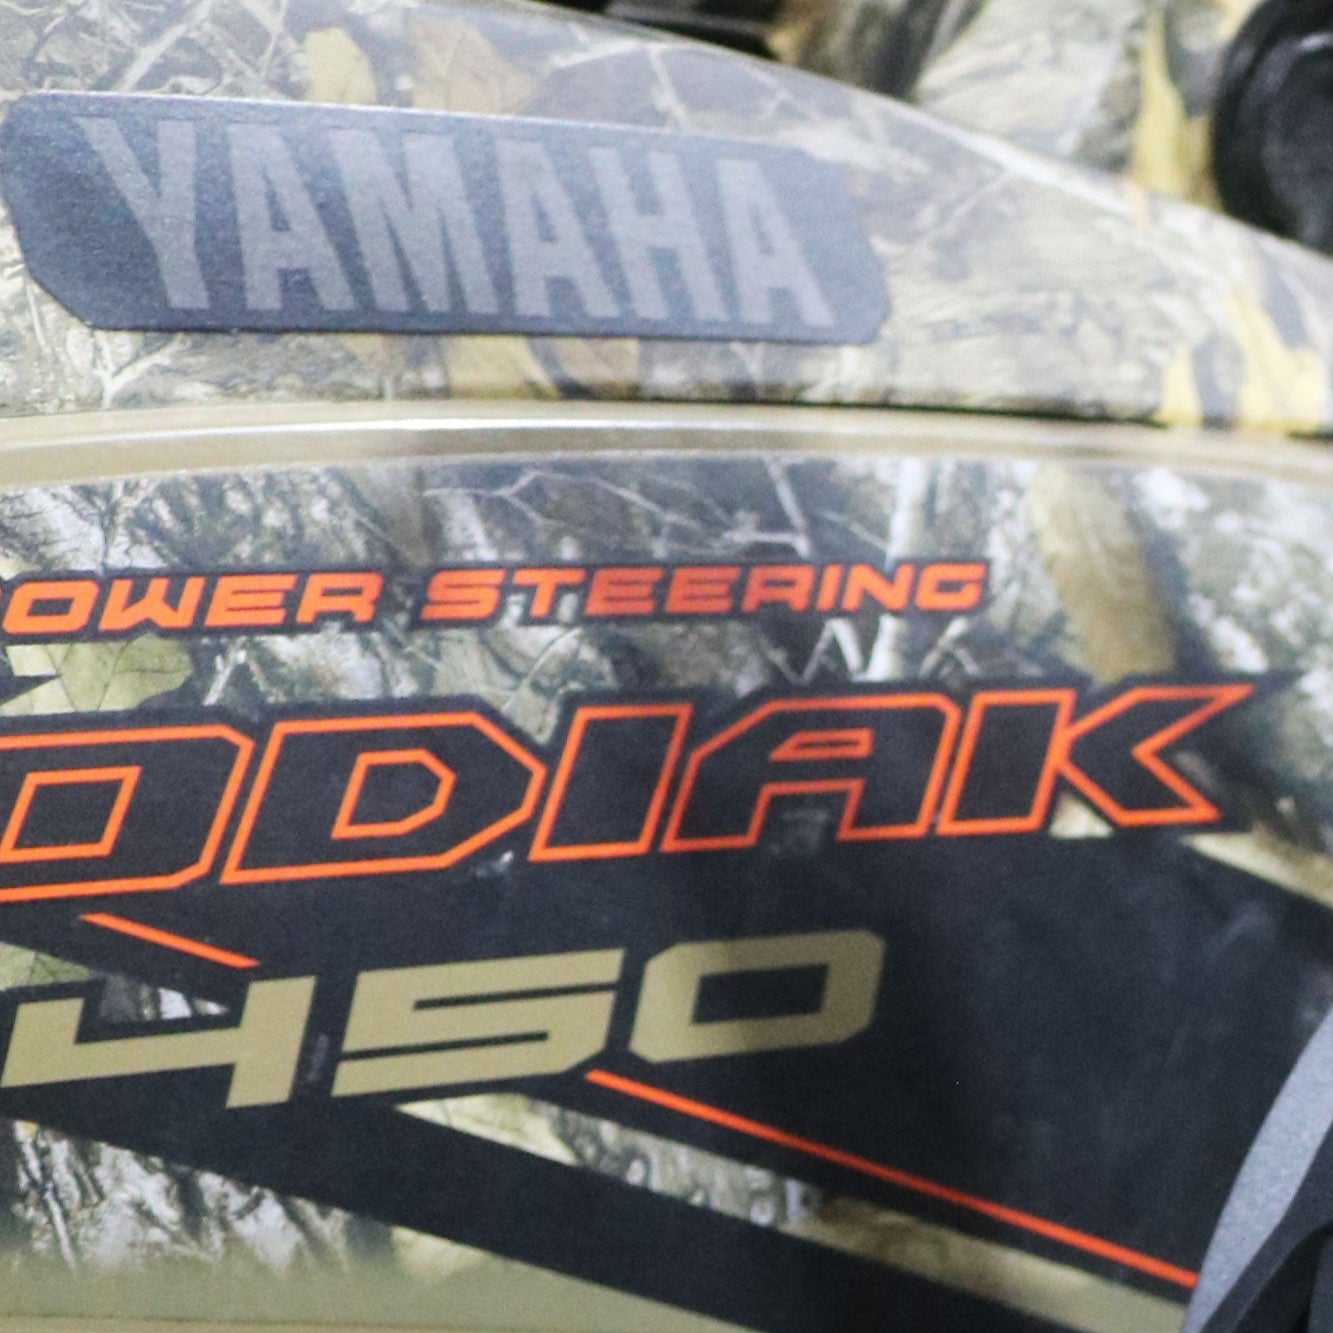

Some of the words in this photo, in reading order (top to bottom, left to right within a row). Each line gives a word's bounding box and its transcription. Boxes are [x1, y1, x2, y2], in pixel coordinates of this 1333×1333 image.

[74, 114, 836, 327] YAMAHA
[0, 562, 383, 635] OWER
[420, 562, 987, 620] STEERING
[0, 682, 1256, 902] ODIAK
[0, 929, 886, 1109] 450
